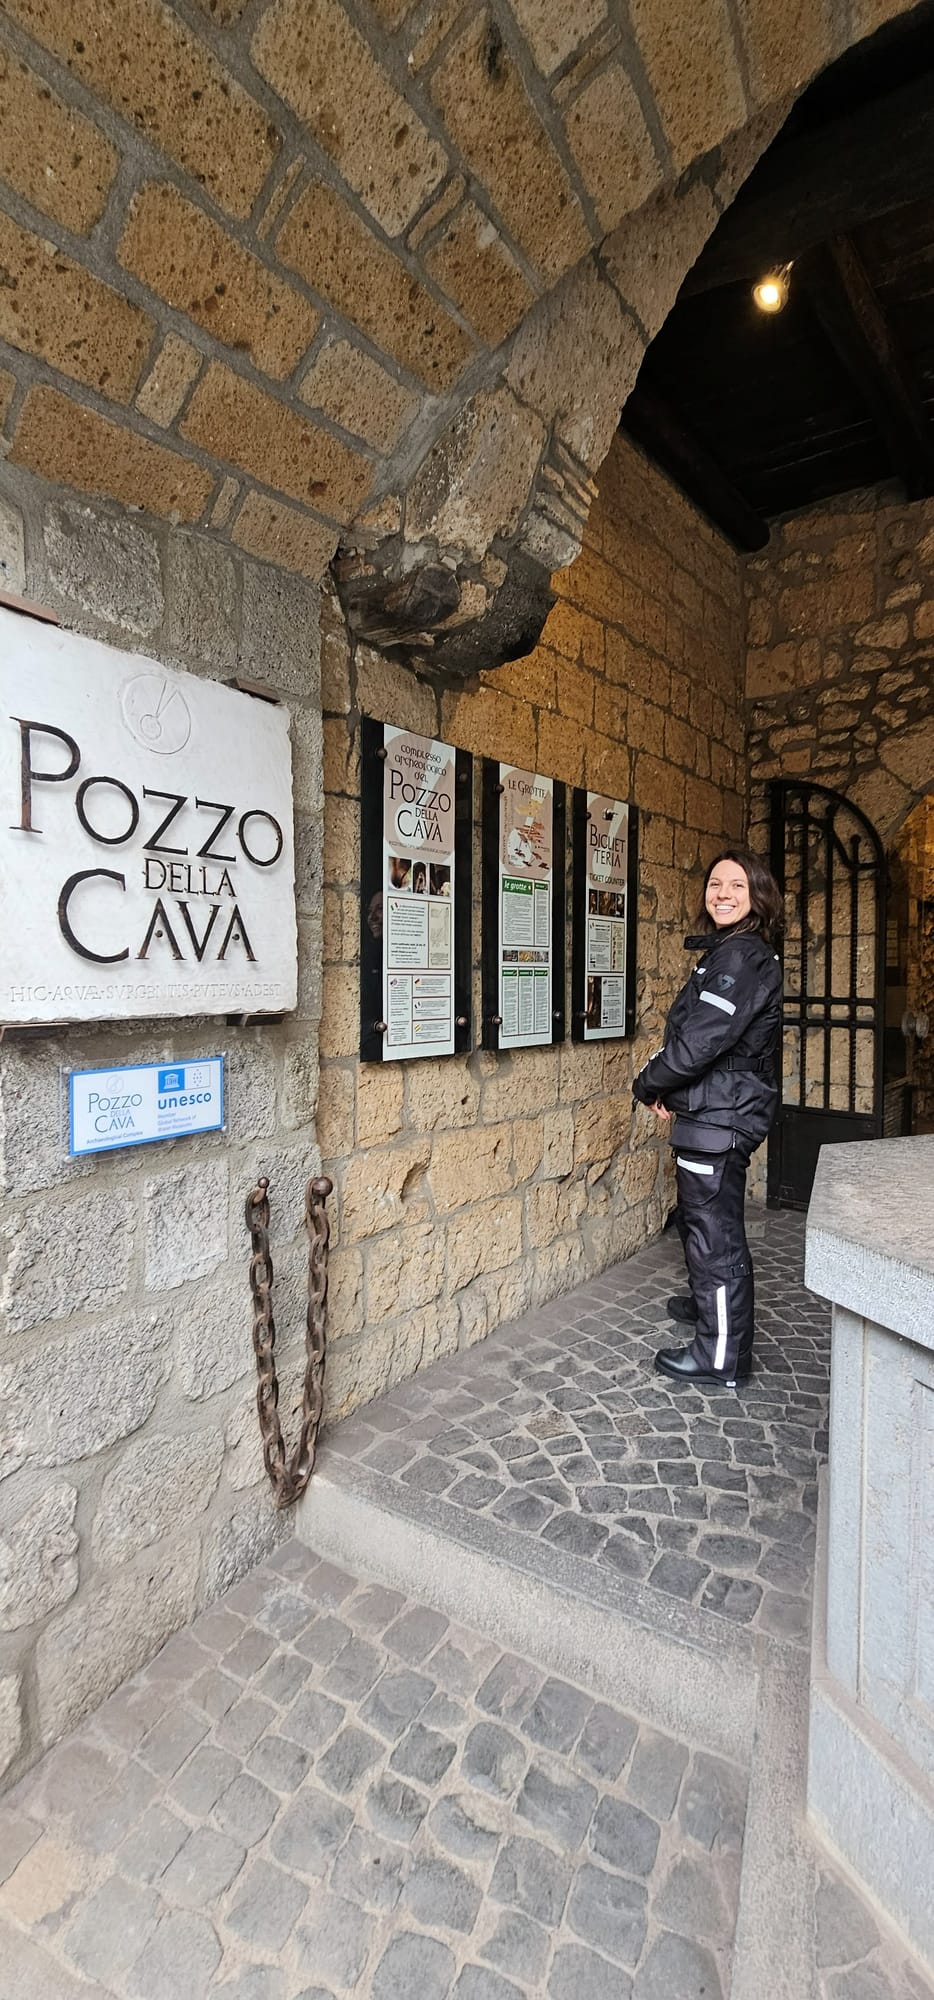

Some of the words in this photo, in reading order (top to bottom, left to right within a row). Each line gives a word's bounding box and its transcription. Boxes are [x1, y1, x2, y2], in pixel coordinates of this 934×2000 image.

[401, 744, 442, 764] complesso
[9, 716, 284, 868] POZZO
[388, 767, 451, 813] POZZO
[508, 779, 517, 791] LE
[518, 780, 547, 799] GROTTE
[415, 807, 438, 822] DELLA
[397, 809, 443, 843] CAVA
[594, 848, 621, 869] TERIA
[143, 857, 239, 898] DELLA
[589, 872, 605, 883] TICKET
[605, 876, 625, 887] COUNTER
[57, 868, 260, 964] CAVA
[88, 1092, 142, 1113] POZZO
[158, 1092, 212, 1110] unesco
[110, 1108, 131, 1119] DELLA
[94, 1115, 136, 1133] CAVA
